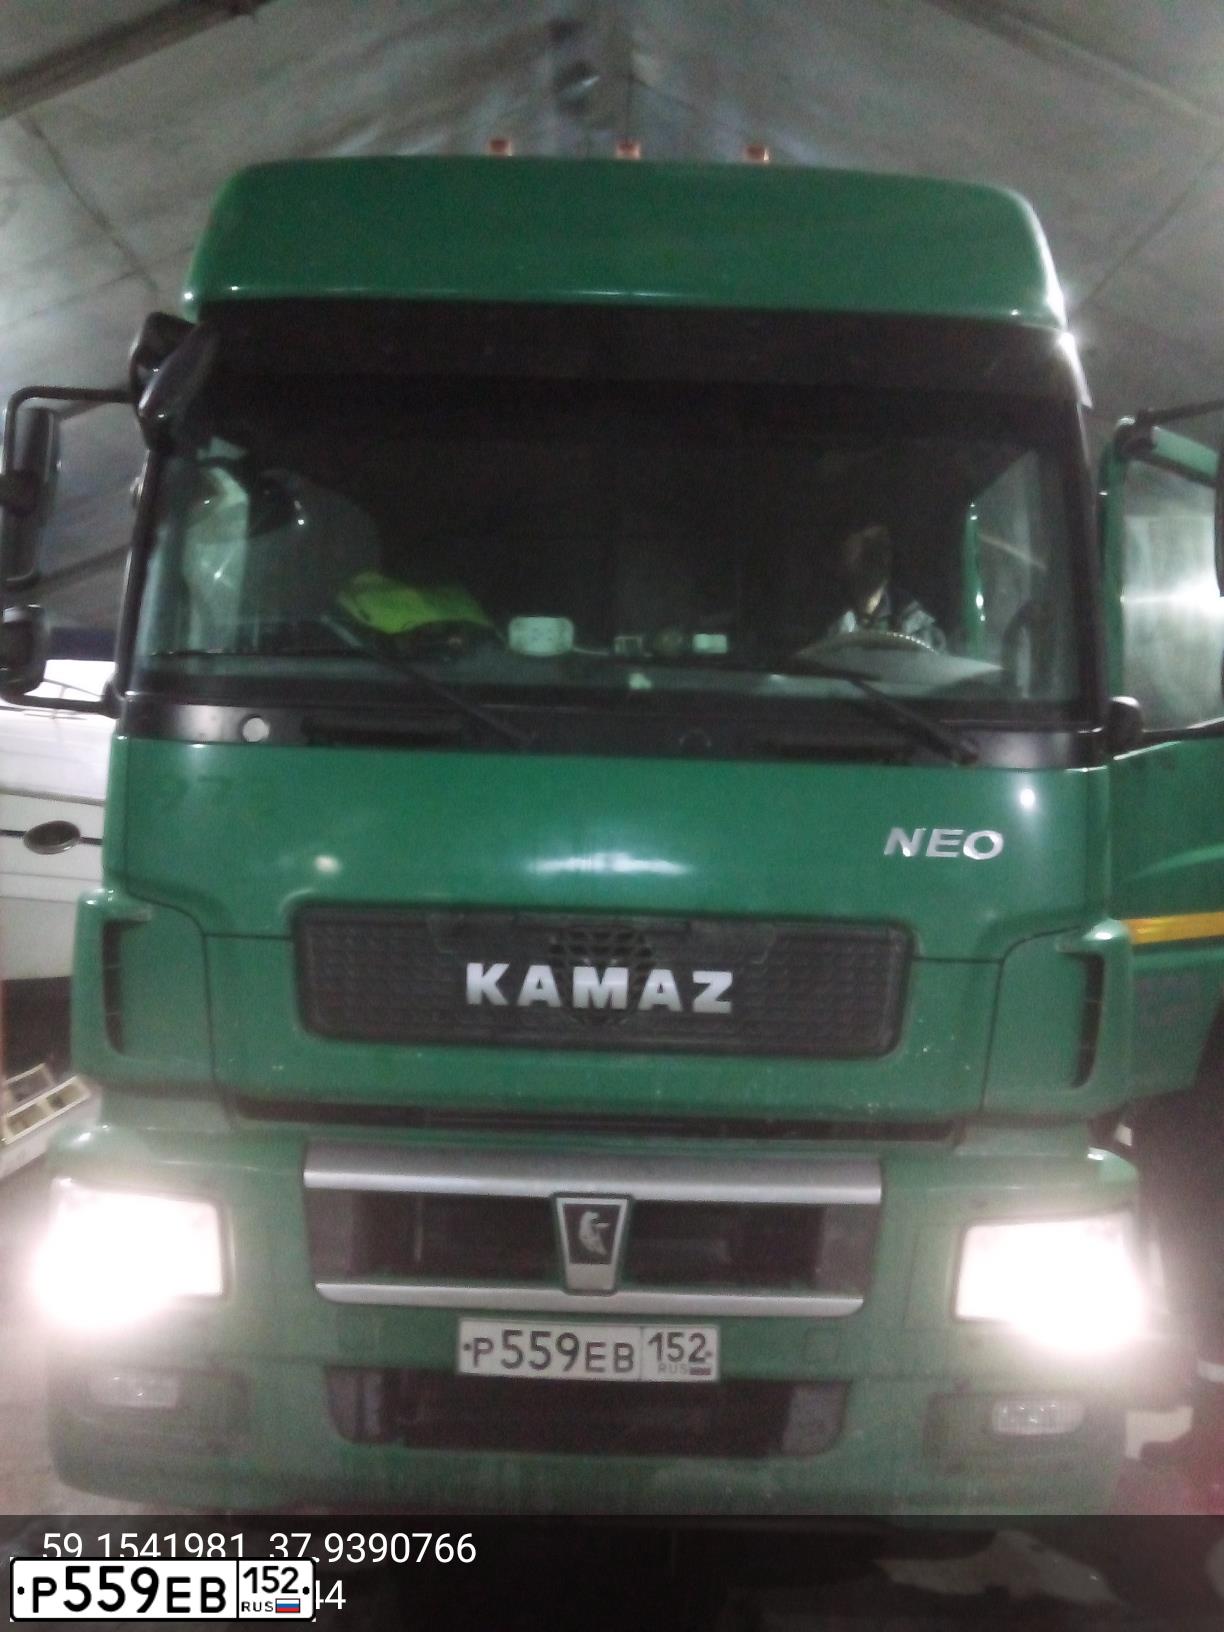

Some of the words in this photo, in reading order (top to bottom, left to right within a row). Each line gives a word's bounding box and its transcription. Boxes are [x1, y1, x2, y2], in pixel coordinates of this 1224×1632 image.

[883, 827, 1004, 860] NEO
[466, 962, 733, 1013] KAMAZ
[648, 1332, 706, 1362] 152
[657, 1363, 688, 1374] RUS
